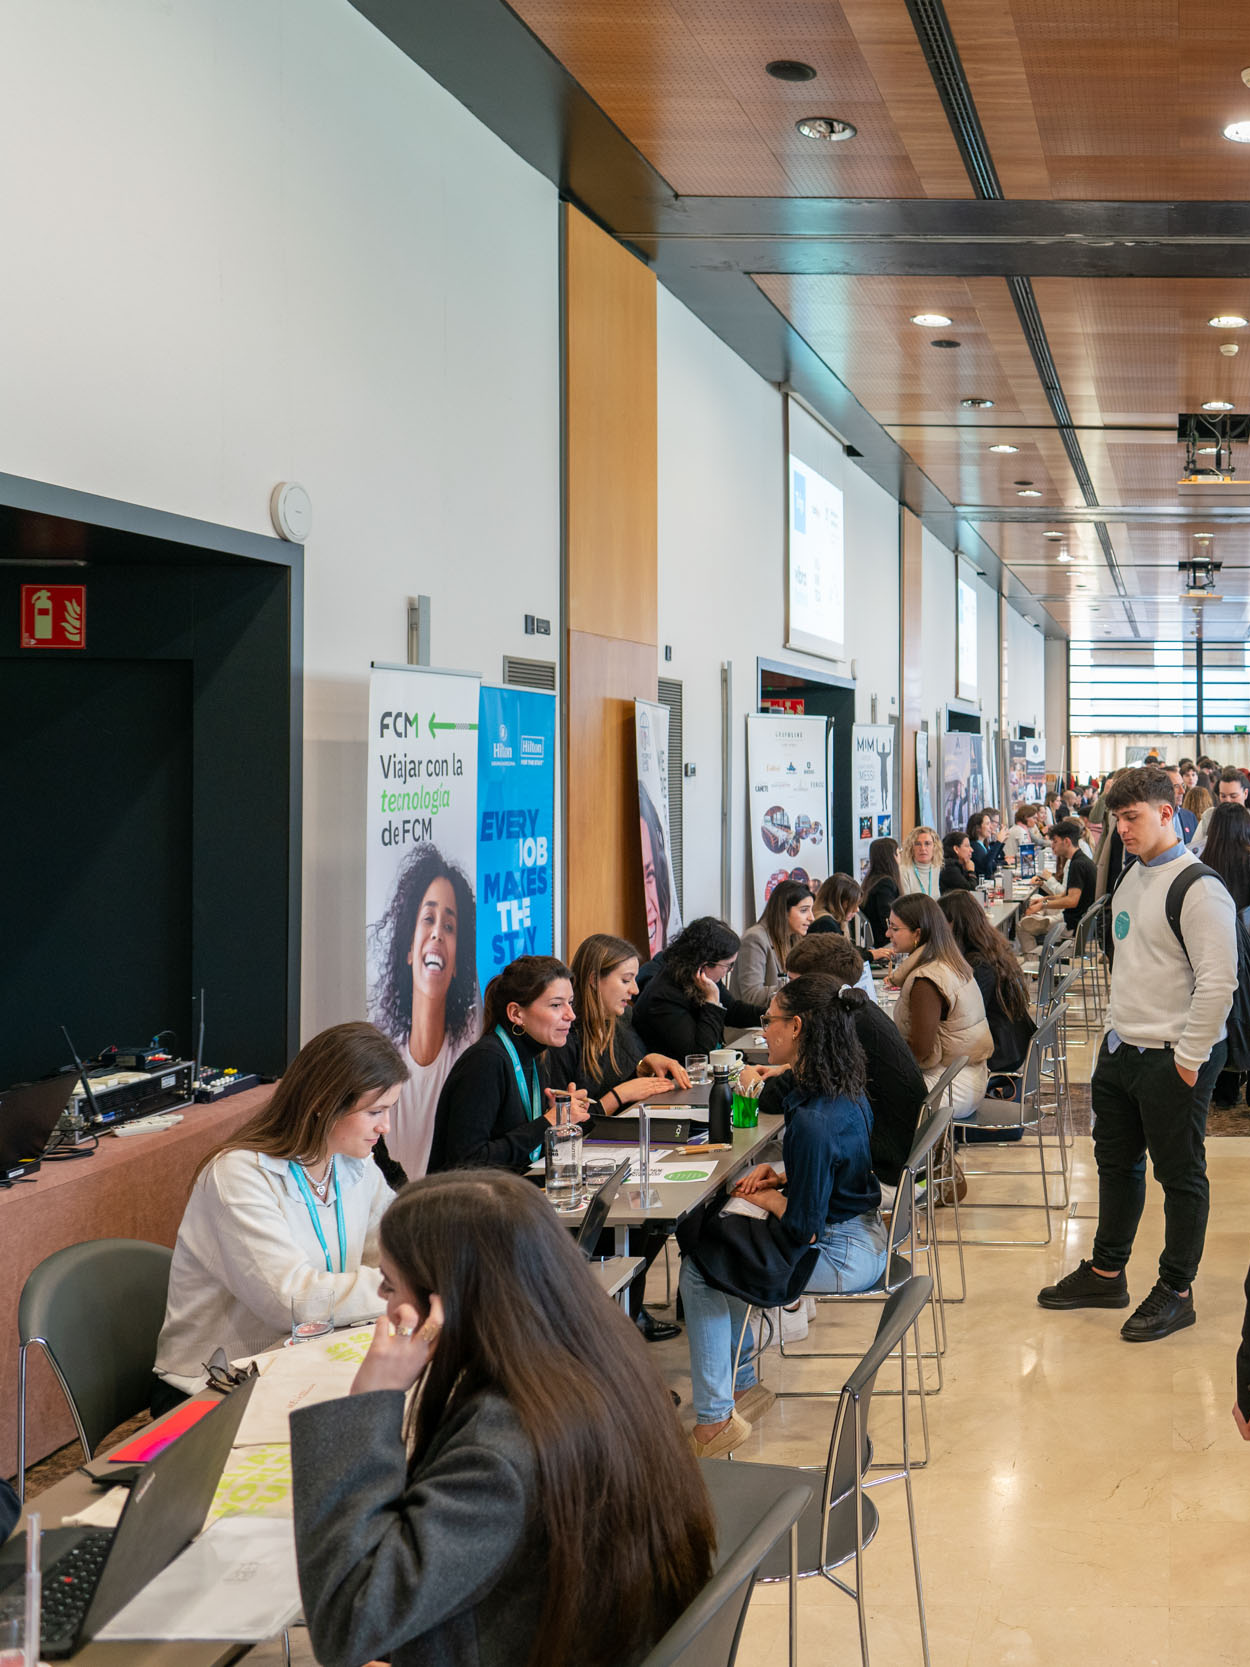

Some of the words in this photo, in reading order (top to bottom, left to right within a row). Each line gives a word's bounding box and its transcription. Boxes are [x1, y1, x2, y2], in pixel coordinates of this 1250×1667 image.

[380, 711, 419, 738] FCM
[522, 740, 542, 753] Hilton
[380, 753, 422, 784] Viajar
[426, 759, 448, 777] con
[452, 752, 463, 776] la
[381, 783, 450, 815] tecnología
[381, 820, 399, 846] de
[402, 818, 432, 843] FCM
[480, 809, 540, 842] EVERY
